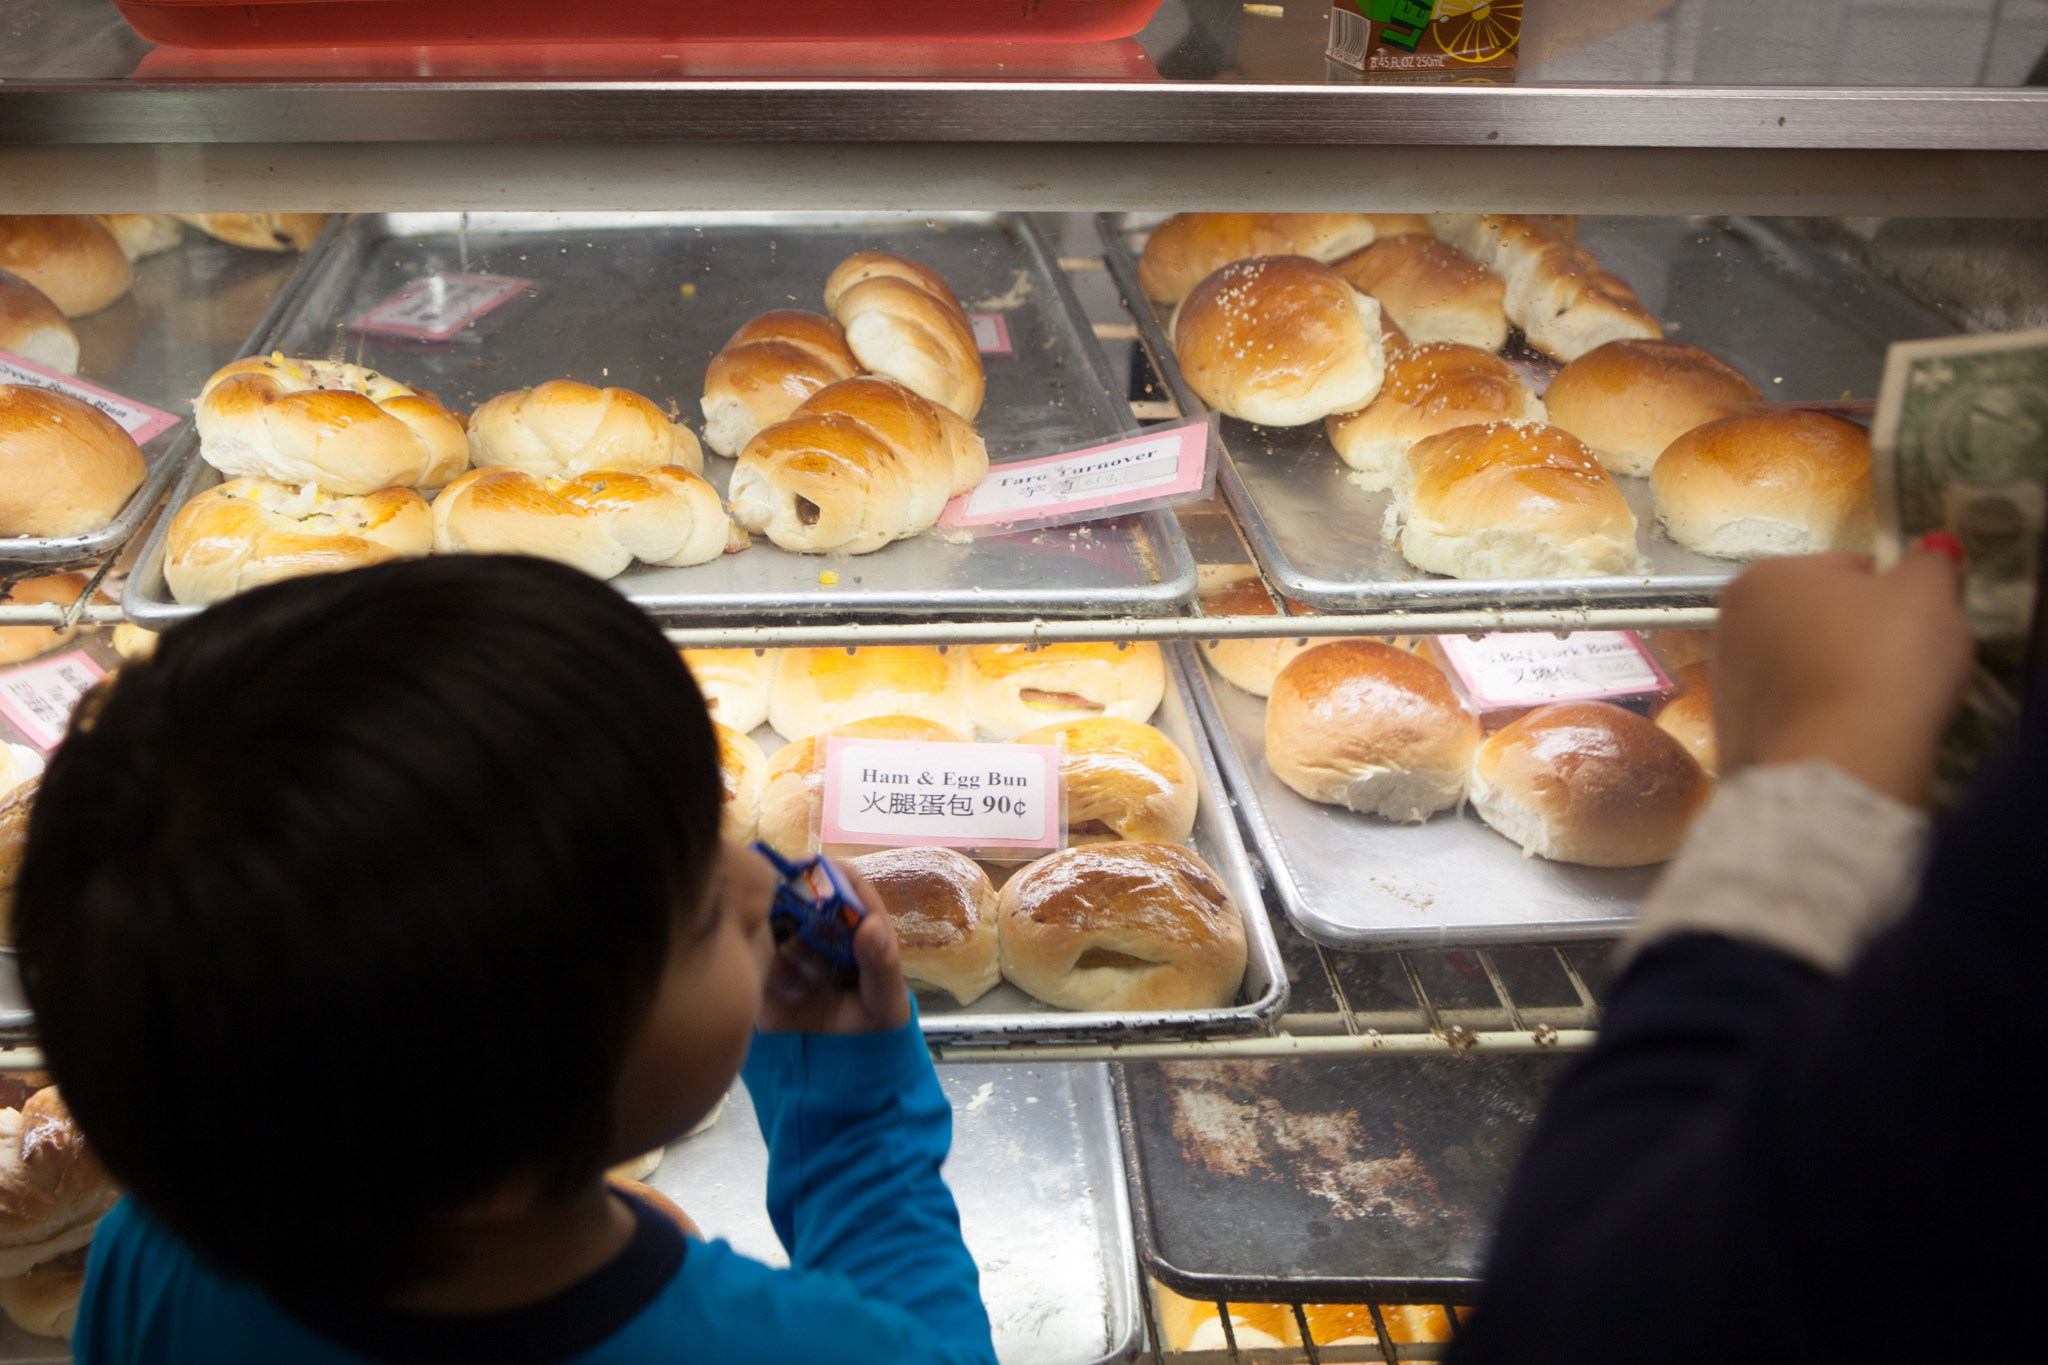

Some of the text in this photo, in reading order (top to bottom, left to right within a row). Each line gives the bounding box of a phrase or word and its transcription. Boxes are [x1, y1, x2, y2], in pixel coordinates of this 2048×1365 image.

[1380, 0, 1434, 53] LE
[1401, 57, 1415, 67] OZ
[1416, 56, 1445, 67] 250mL
[997, 474, 1048, 487] Taro
[1059, 450, 1158, 477] Turnover
[861, 768, 1028, 789] Ham & Egg Bun
[859, 791, 1027, 818] 火腿蛋包 90¢
